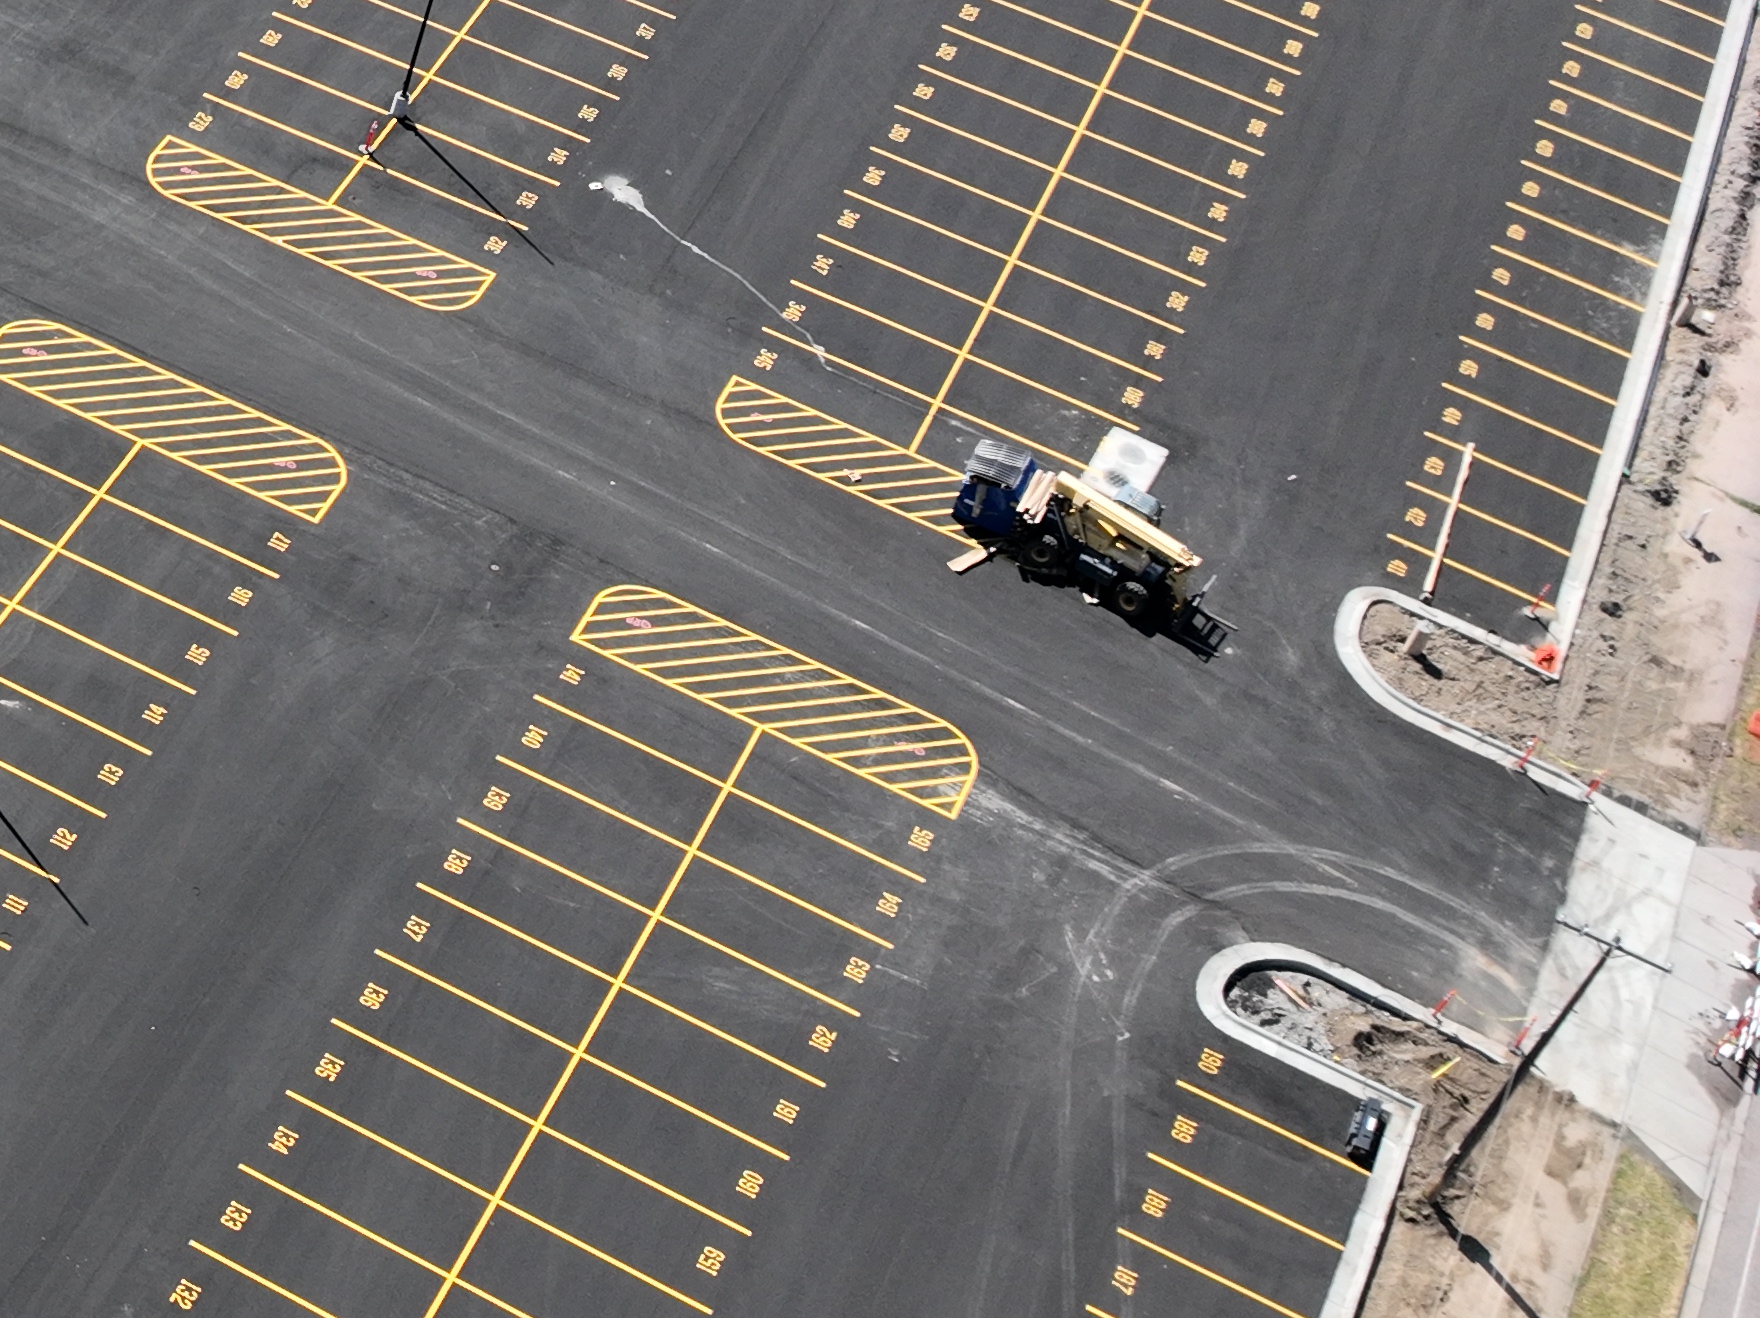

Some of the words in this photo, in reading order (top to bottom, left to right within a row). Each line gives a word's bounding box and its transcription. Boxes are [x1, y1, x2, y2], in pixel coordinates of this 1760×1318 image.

[636, 25, 654, 39] 317
[578, 105, 599, 120] 315
[518, 192, 538, 208] 313
[484, 236, 507, 252] 312
[783, 303, 806, 321] 346
[754, 351, 778, 370] 345
[269, 532, 291, 552] 117
[186, 644, 210, 665] 115
[560, 664, 583, 685] 141
[98, 764, 123, 785] 113
[483, 786, 510, 810] 139
[908, 826, 934, 852] 165
[3, 895, 28, 915] 111
[404, 915, 430, 942] 137
[843, 957, 871, 983] 163
[315, 1053, 345, 1081] 135
[1198, 1048, 1224, 1074] 190
[773, 1099, 800, 1124] 161
[1142, 1189, 1170, 1217] 188
[220, 1201, 252, 1231] 133
[696, 1247, 726, 1276] 159
